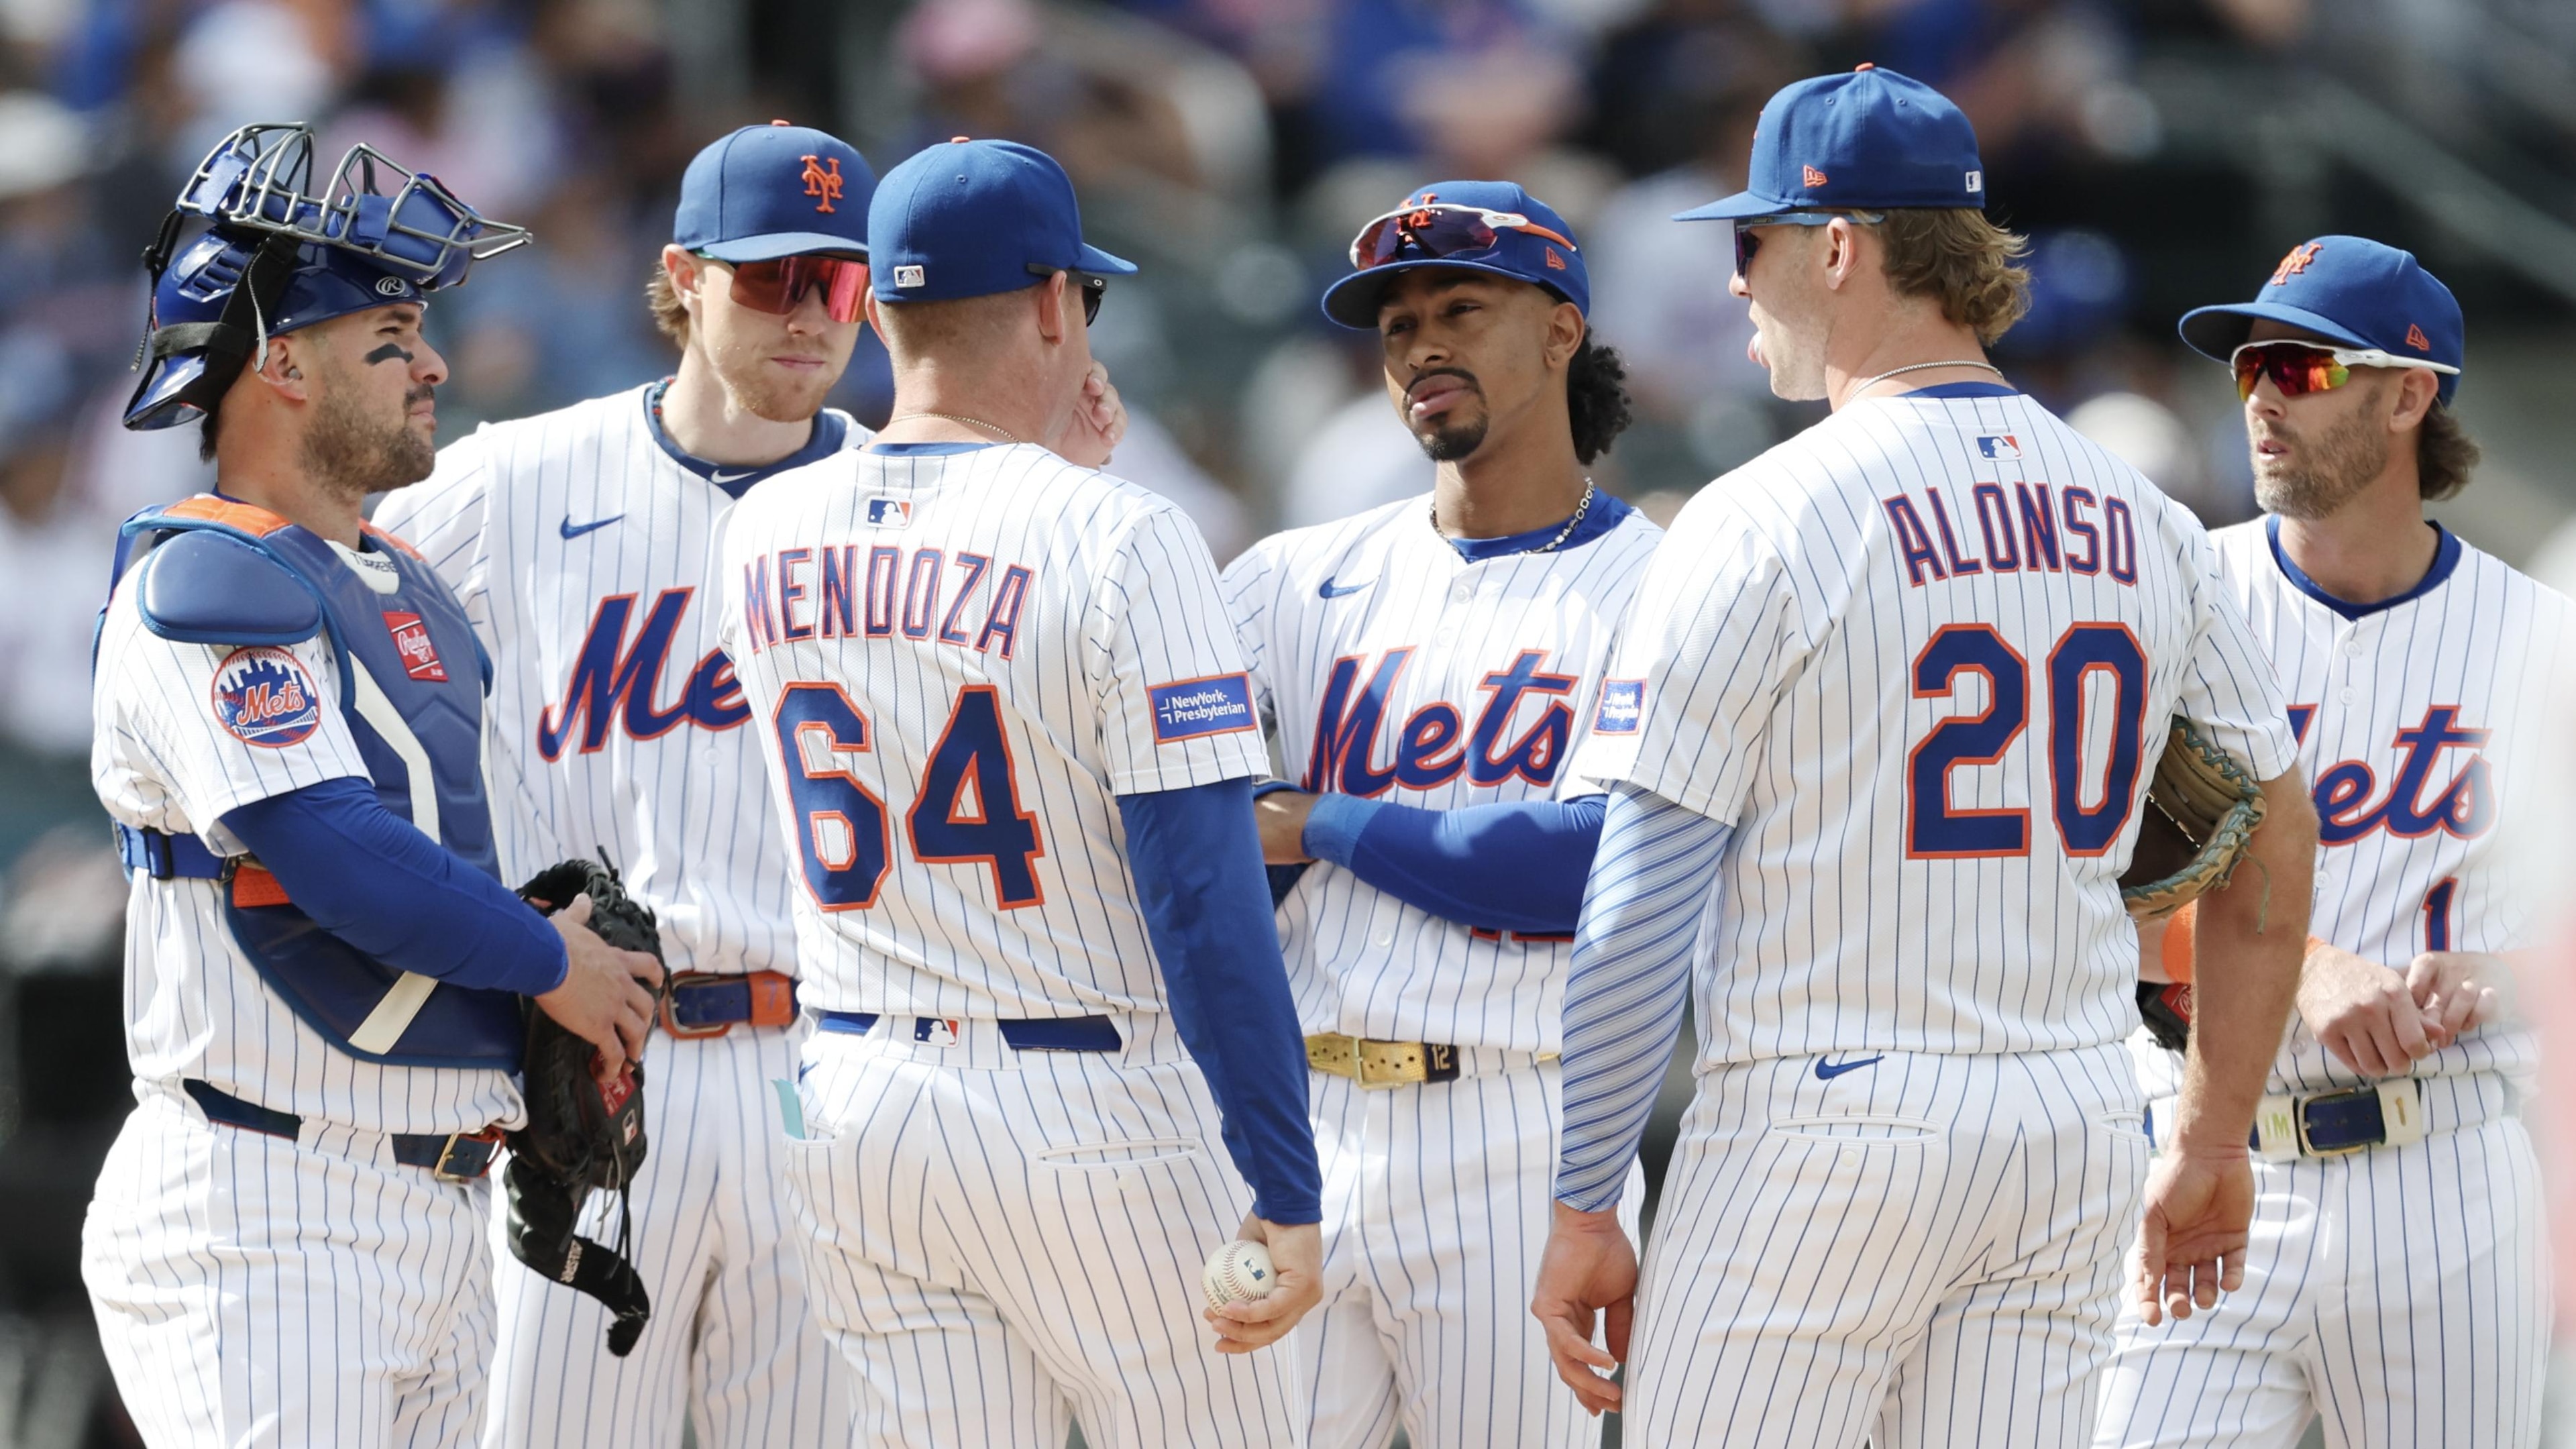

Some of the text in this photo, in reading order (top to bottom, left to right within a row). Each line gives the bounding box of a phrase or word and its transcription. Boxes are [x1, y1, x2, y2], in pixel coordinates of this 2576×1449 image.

[1883, 481, 2138, 588] ALONSO
[744, 545, 1034, 661] MENDOZA
[236, 680, 305, 726] Mets
[537, 586, 753, 763] Me
[1172, 689, 1228, 710] NewYork-
[1174, 702, 1246, 723] Presbyterian
[1302, 645, 1580, 799] Mets
[1906, 621, 2149, 859] 20
[773, 681, 1045, 912] 64
[2286, 704, 2496, 847] ets
[2421, 875, 2458, 953] 1
[763, 980, 777, 1011] 7
[1431, 1044, 1450, 1070] 12
[2396, 1096, 2407, 1126] 1
